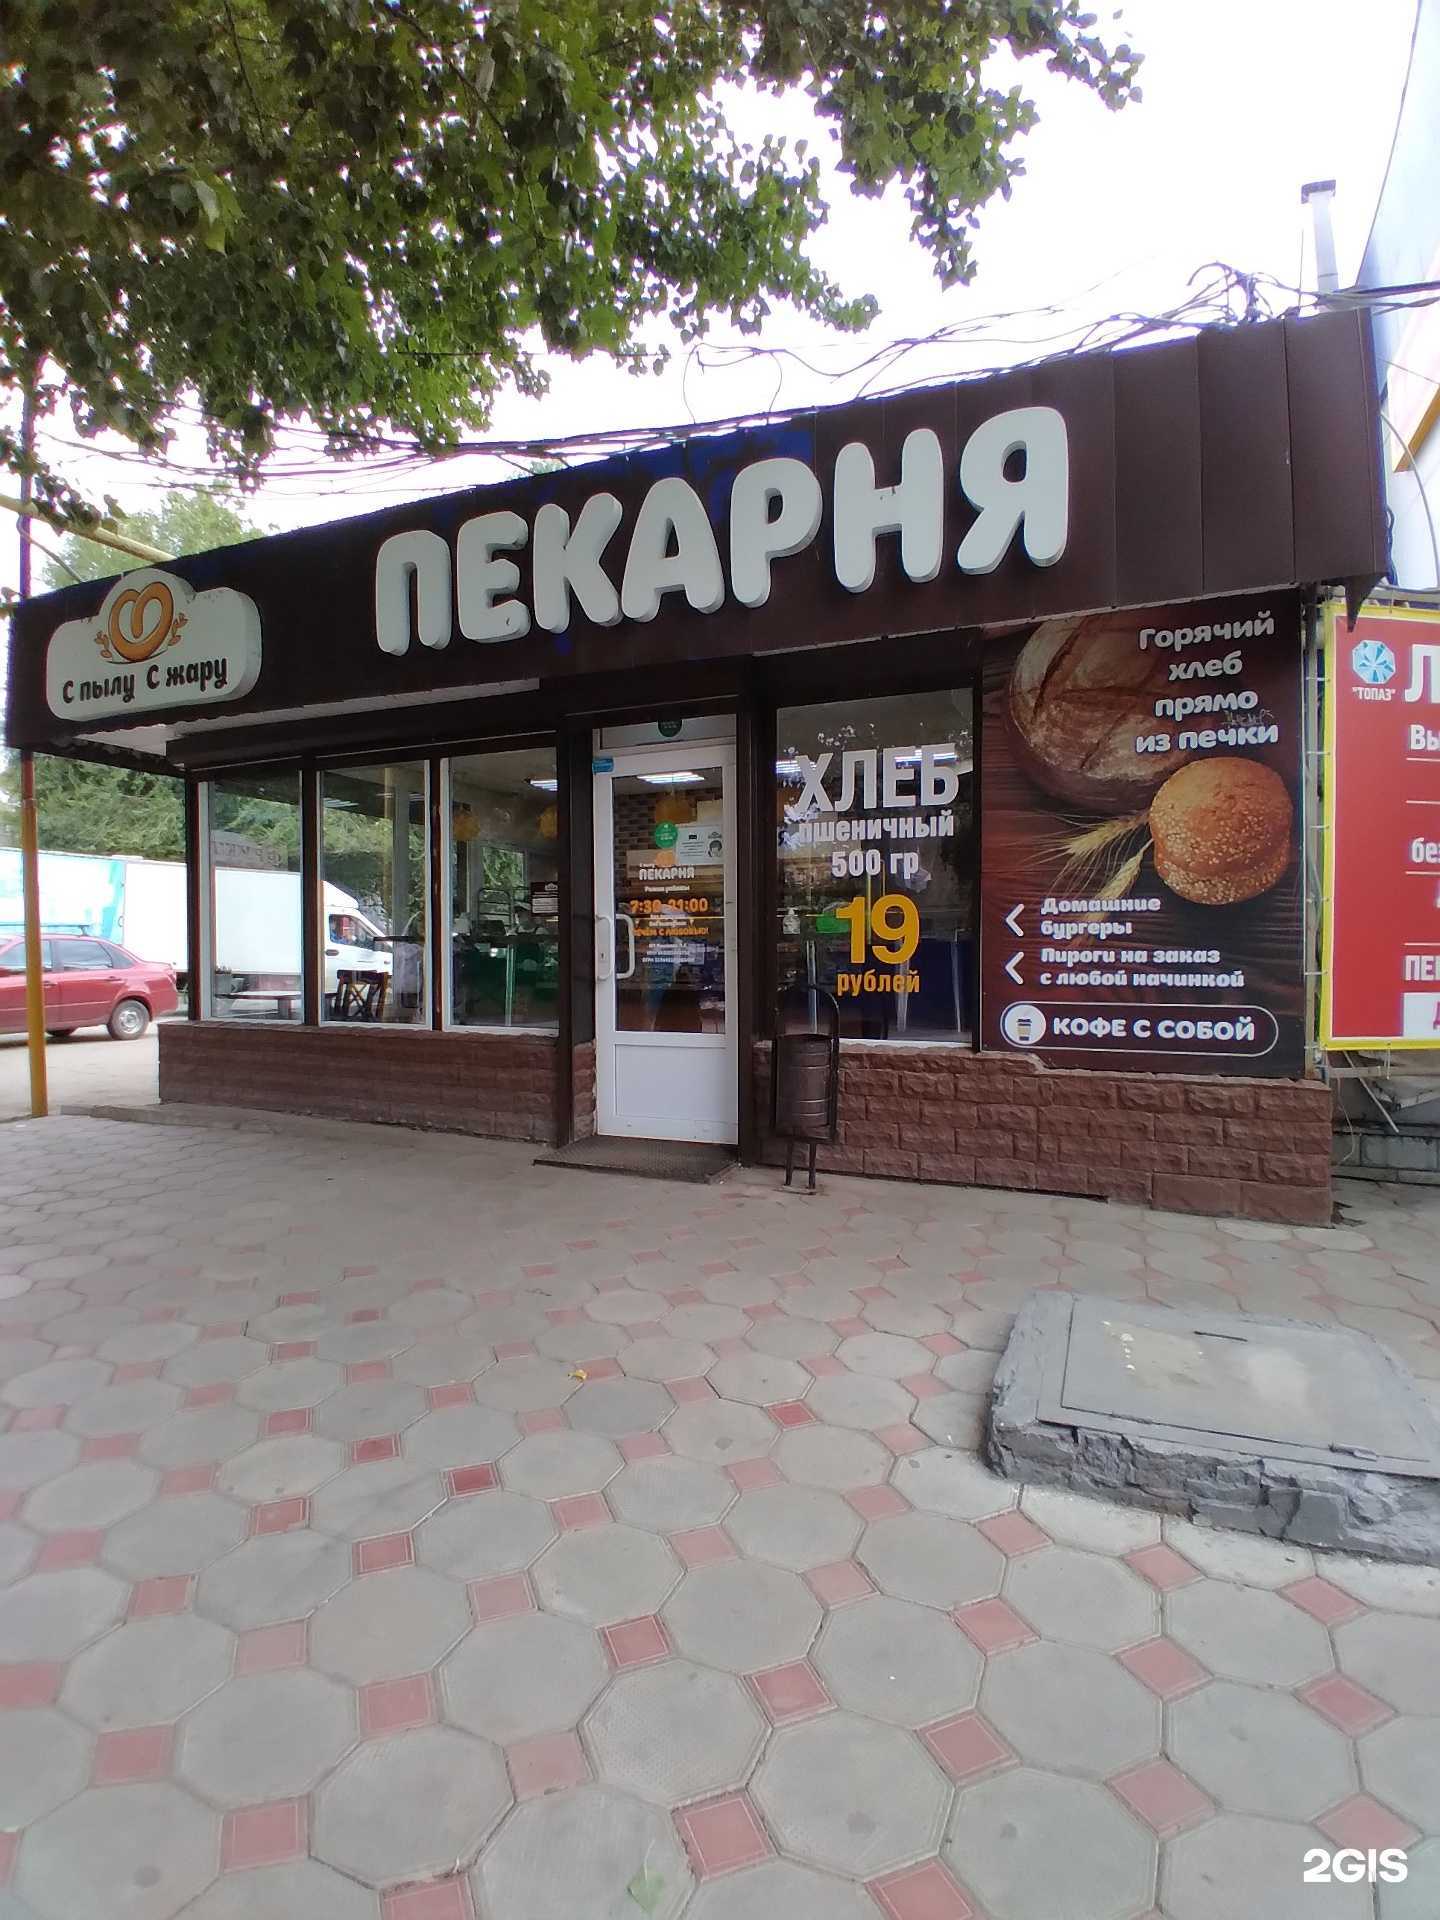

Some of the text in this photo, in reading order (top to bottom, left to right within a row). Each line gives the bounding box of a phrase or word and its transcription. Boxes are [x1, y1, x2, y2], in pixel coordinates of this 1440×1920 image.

[376, 406, 1069, 657] ПЕКАРНЯ
[1139, 610, 1275, 652] Горячий
[1168, 650, 1243, 681] хлеб
[80, 674, 136, 703] пылу
[166, 658, 228, 692] жару
[1352, 686, 1396, 701] "ТОПАЗ"
[1155, 690, 1259, 721] прямо
[1136, 725, 1279, 753] из печки
[796, 743, 960, 812] ХЛЕБ
[799, 810, 954, 841] пшеничный
[639, 867, 695, 880] ПЕКАРНЯ
[832, 849, 919, 880] 500 гр
[1041, 897, 1161, 915] Домашние
[836, 894, 920, 965] 19
[1041, 920, 1132, 940] бургеры
[1041, 948, 1221, 967] Пироги на заказ
[837, 970, 920, 997] рублей
[1040, 970, 1245, 988] с любой начинкой
[1053, 1016, 1255, 1041] КОФЕ С СОБОЙ
